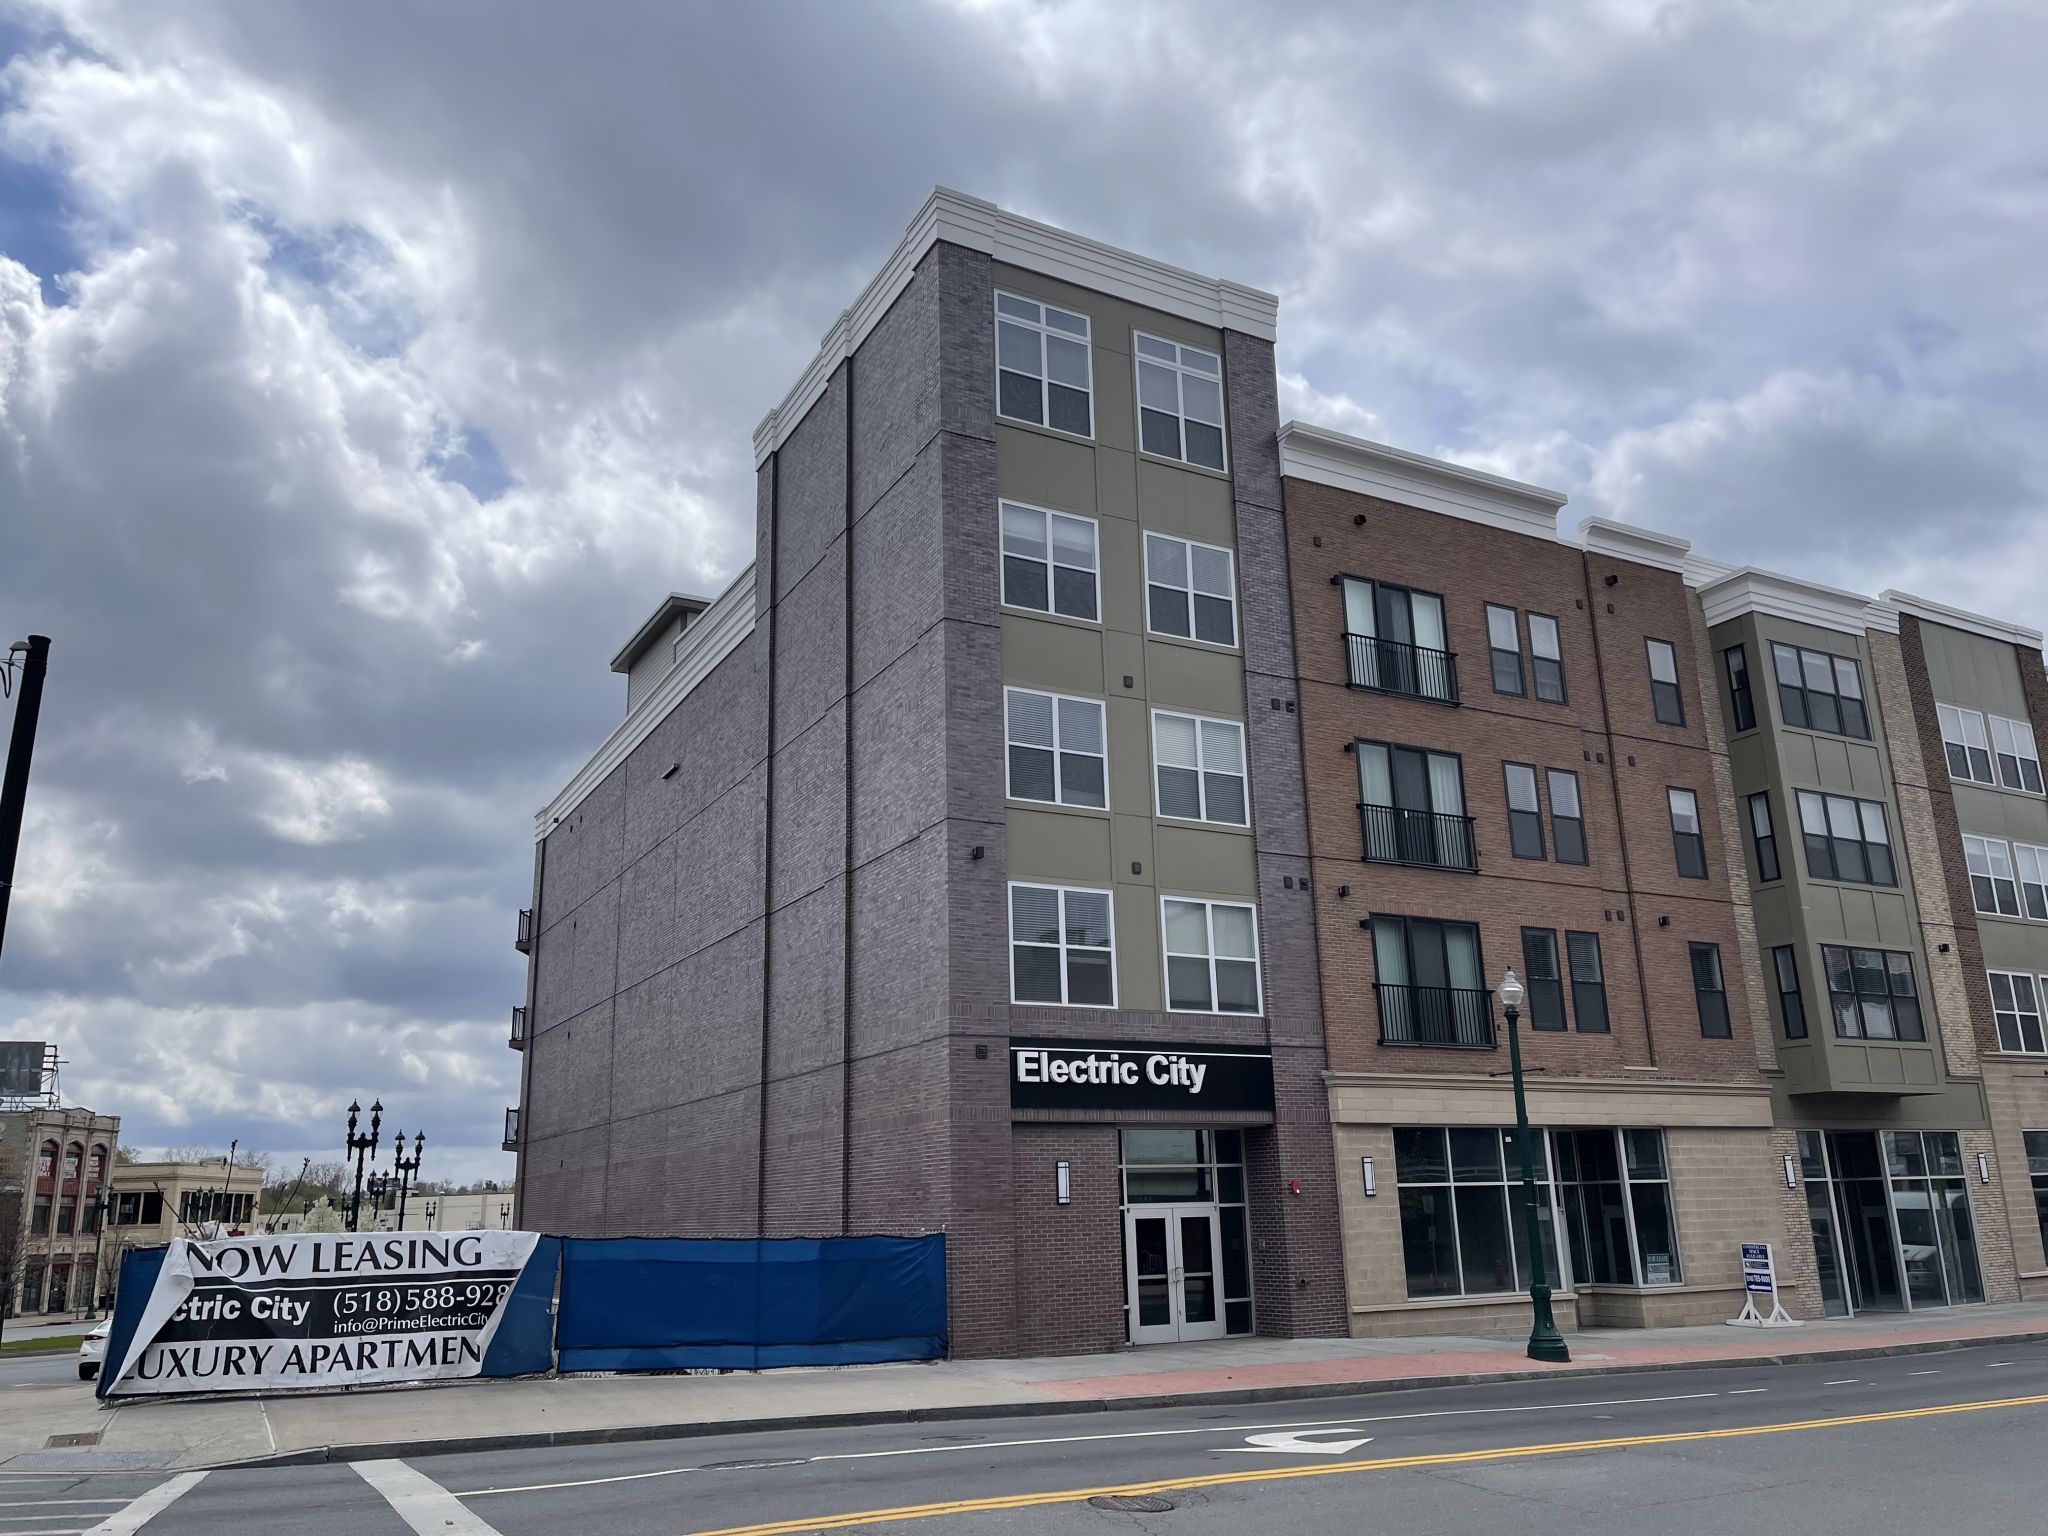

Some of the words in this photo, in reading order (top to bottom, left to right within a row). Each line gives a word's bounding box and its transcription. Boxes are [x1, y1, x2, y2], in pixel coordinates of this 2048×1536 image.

[1016, 1051, 1139, 1085] Electric
[1146, 1054, 1207, 1094] City
[186, 1241, 298, 1279] NOW
[311, 1236, 483, 1273] LEASING
[250, 1295, 311, 1326] City
[333, 1288, 401, 1318] (518)
